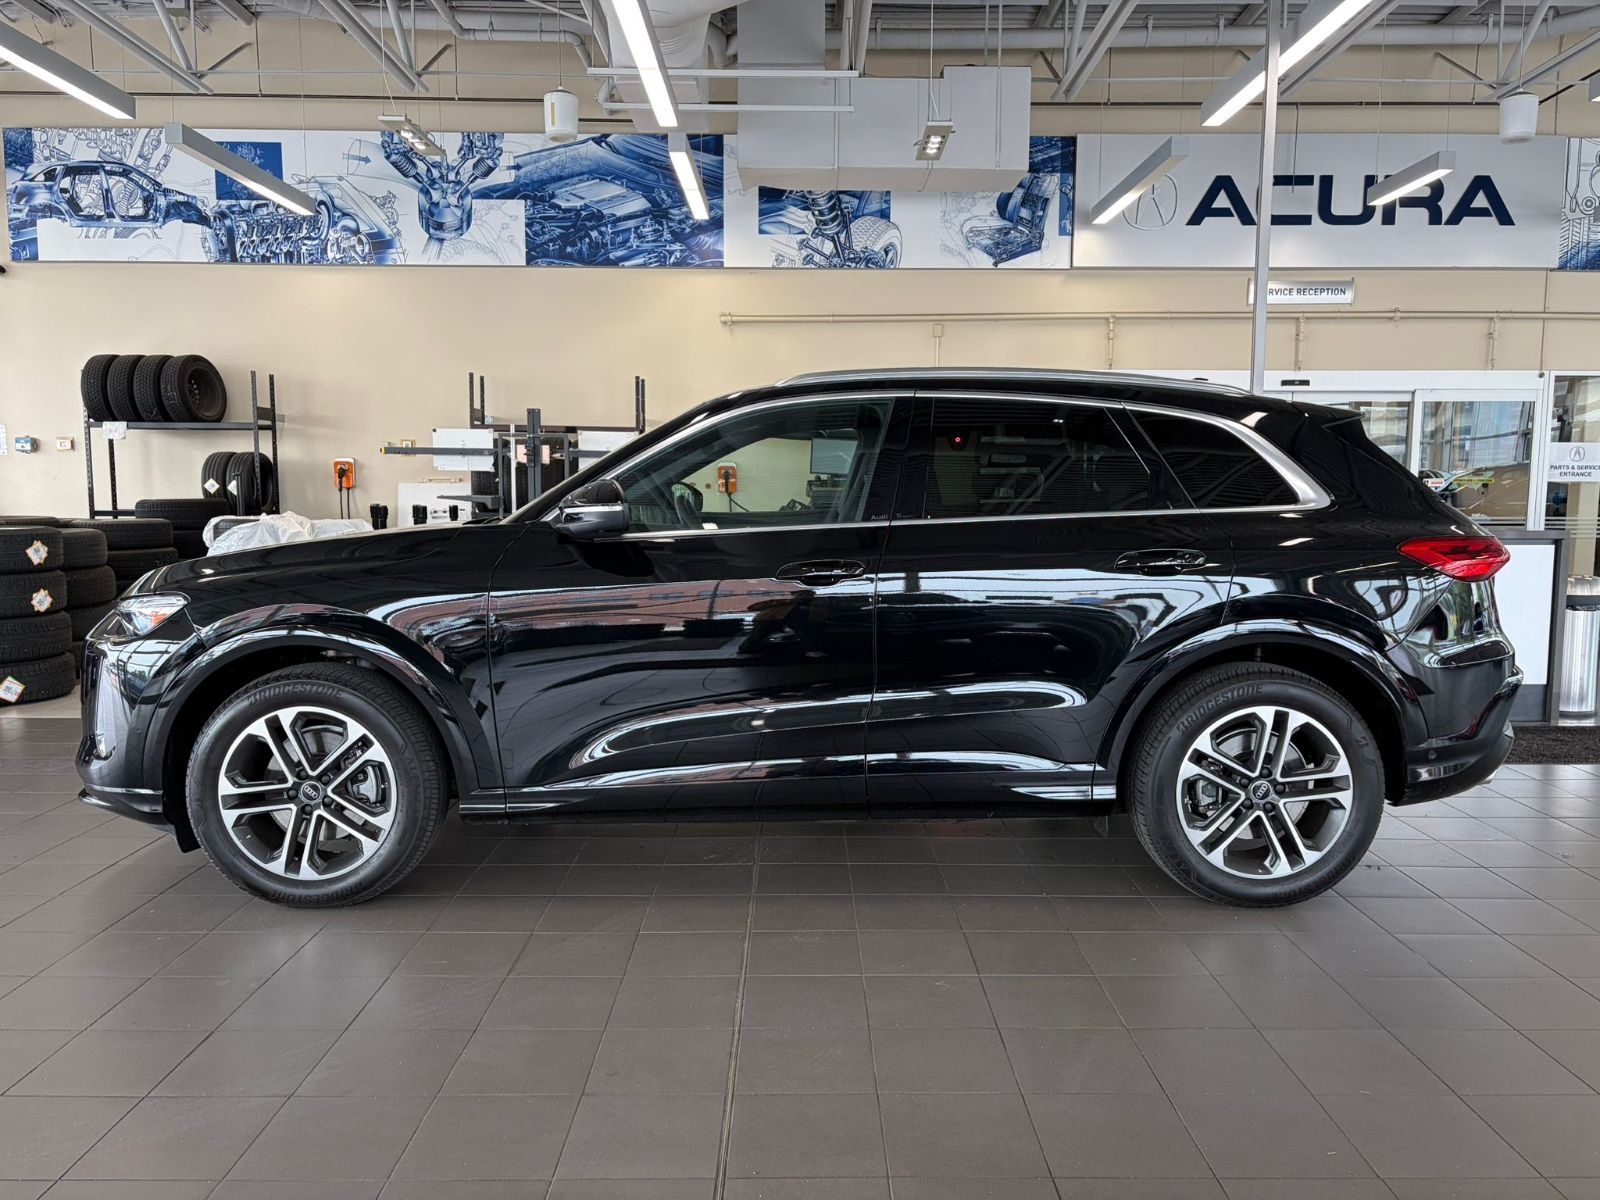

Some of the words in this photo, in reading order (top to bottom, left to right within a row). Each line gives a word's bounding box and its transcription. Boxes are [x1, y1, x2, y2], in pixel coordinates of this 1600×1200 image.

[1185, 174, 1516, 226] ACURA
[1268, 287, 1295, 297] RVICE
[1296, 287, 1347, 297] RECEPTION
[247, 684, 345, 706] BRIDGESTONE
[1176, 683, 1264, 737] BRIDGESTONE
